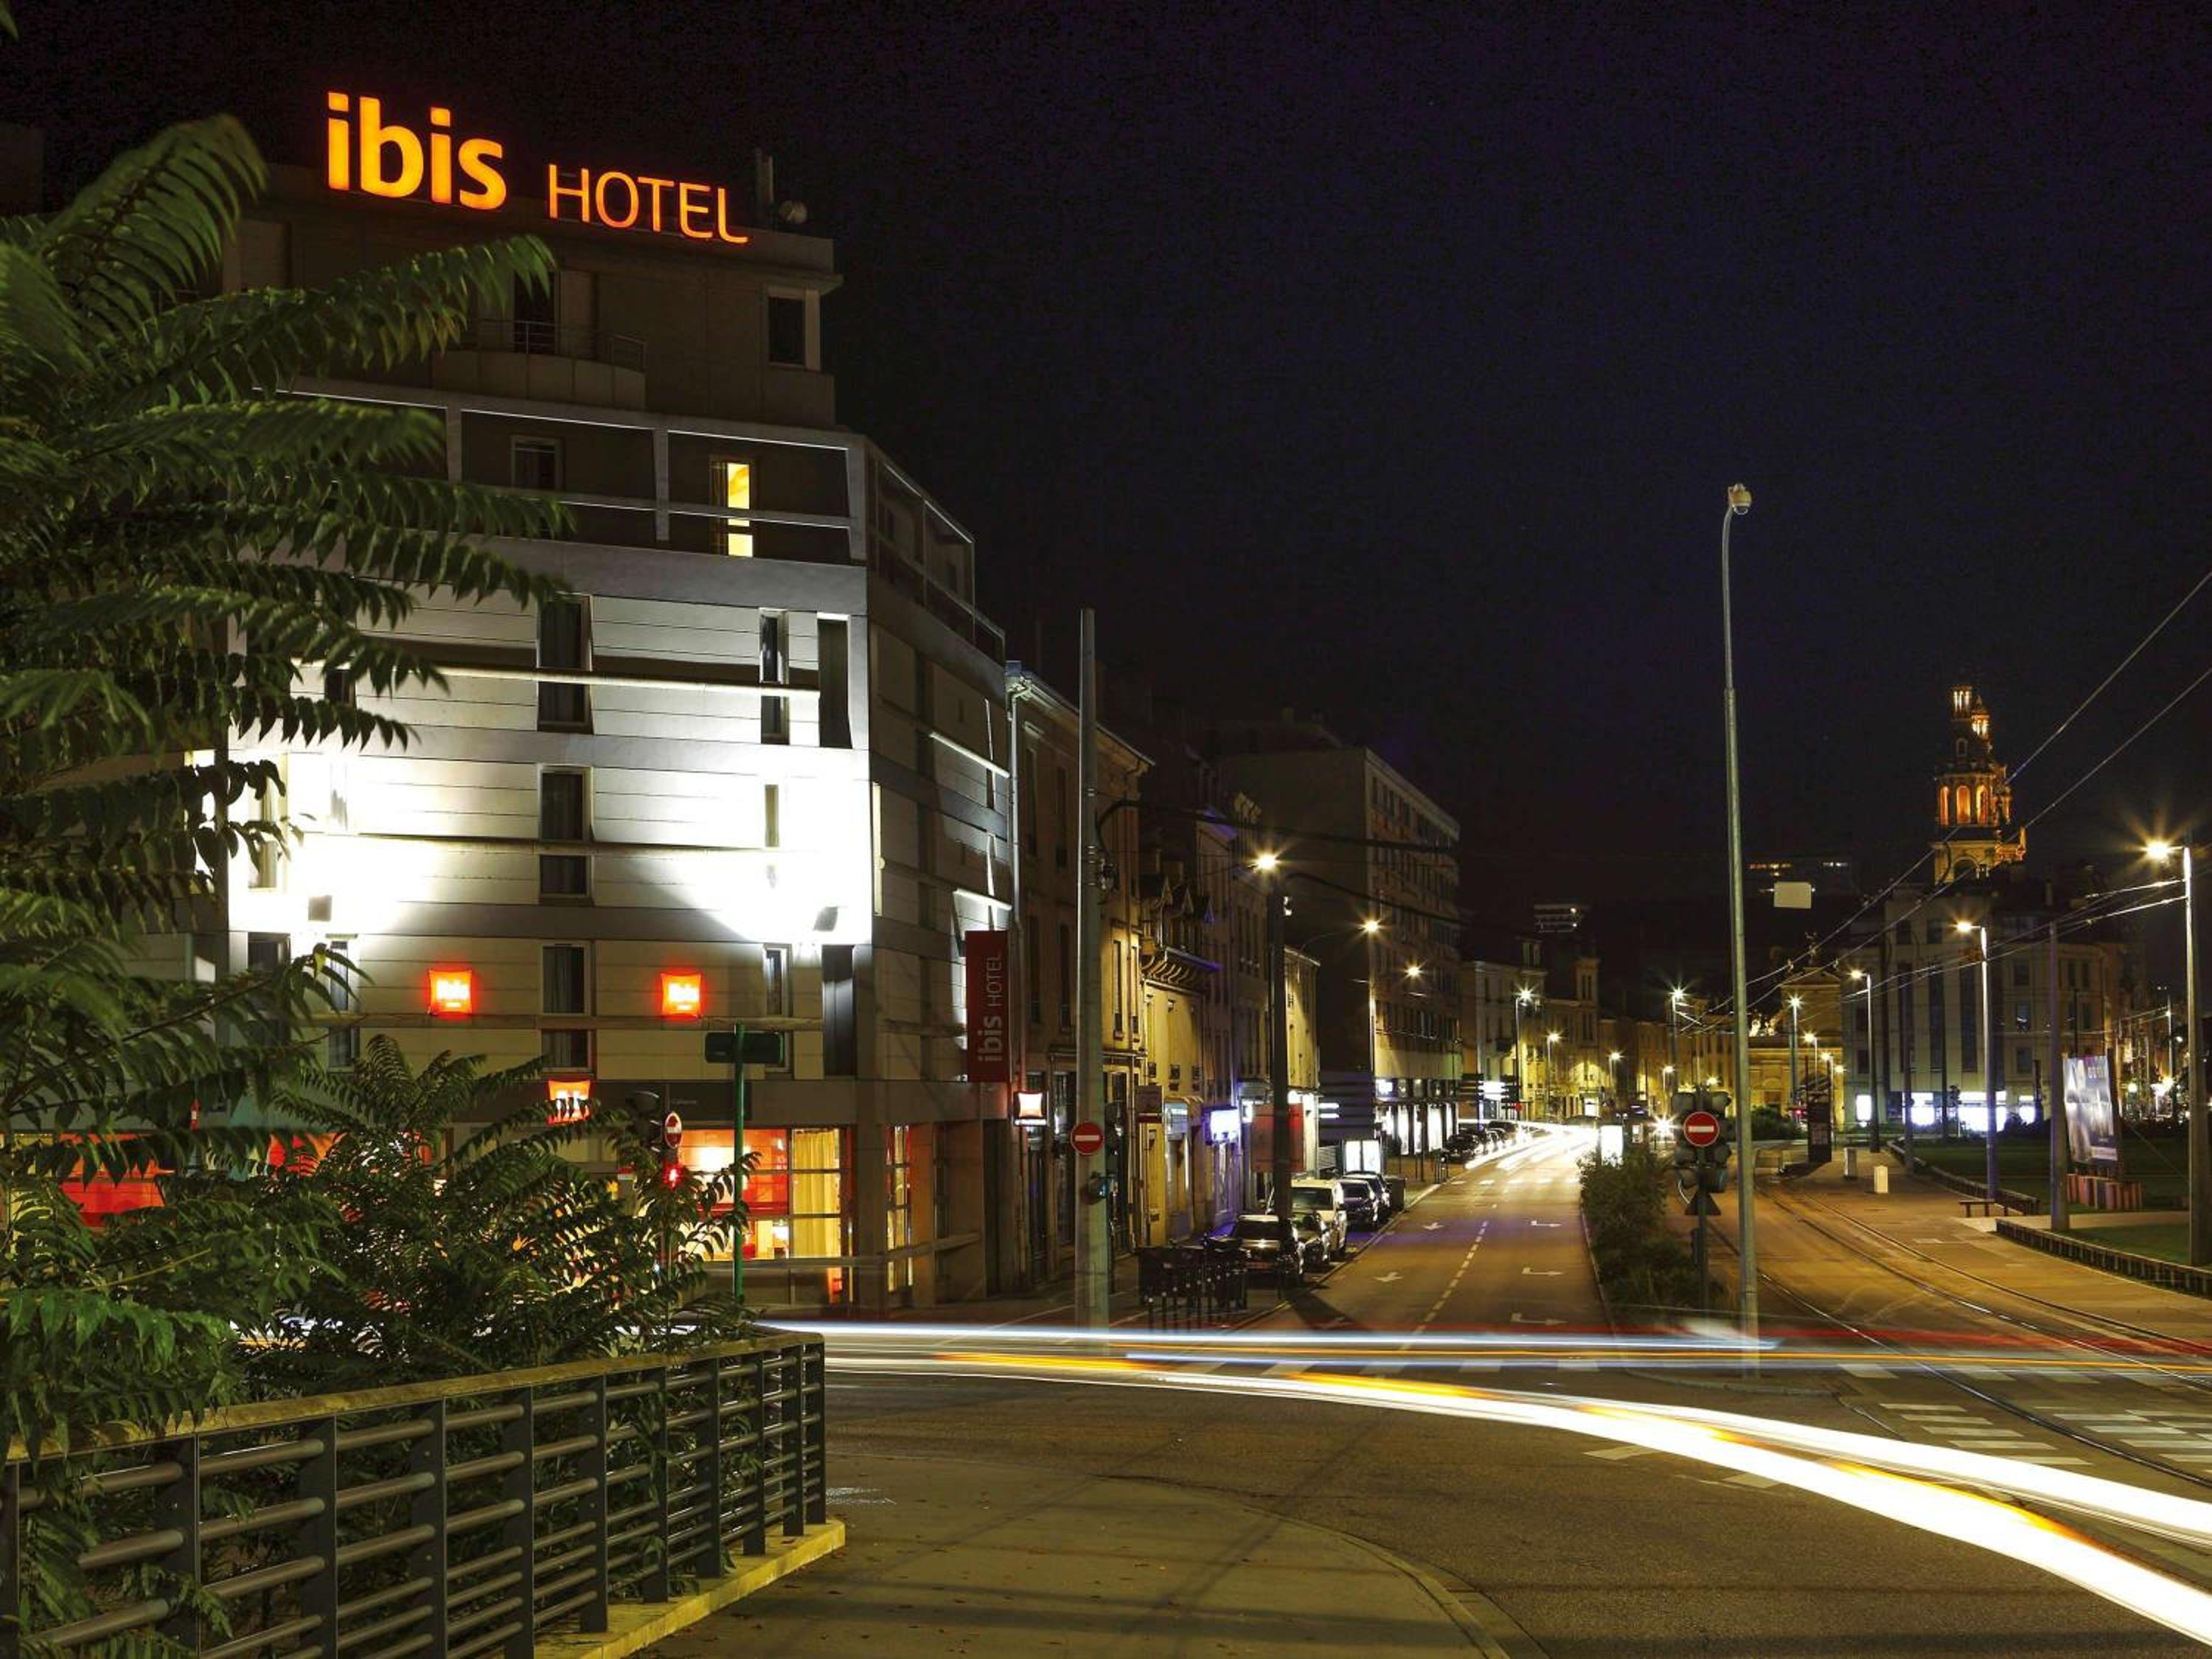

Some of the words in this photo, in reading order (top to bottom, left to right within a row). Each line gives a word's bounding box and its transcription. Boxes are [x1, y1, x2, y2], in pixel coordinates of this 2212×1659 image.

[328, 91, 507, 209] ibis
[548, 164, 748, 243] HOTEL
[985, 953, 1004, 1007] HOTEL
[978, 1015, 1003, 1062] ibis
